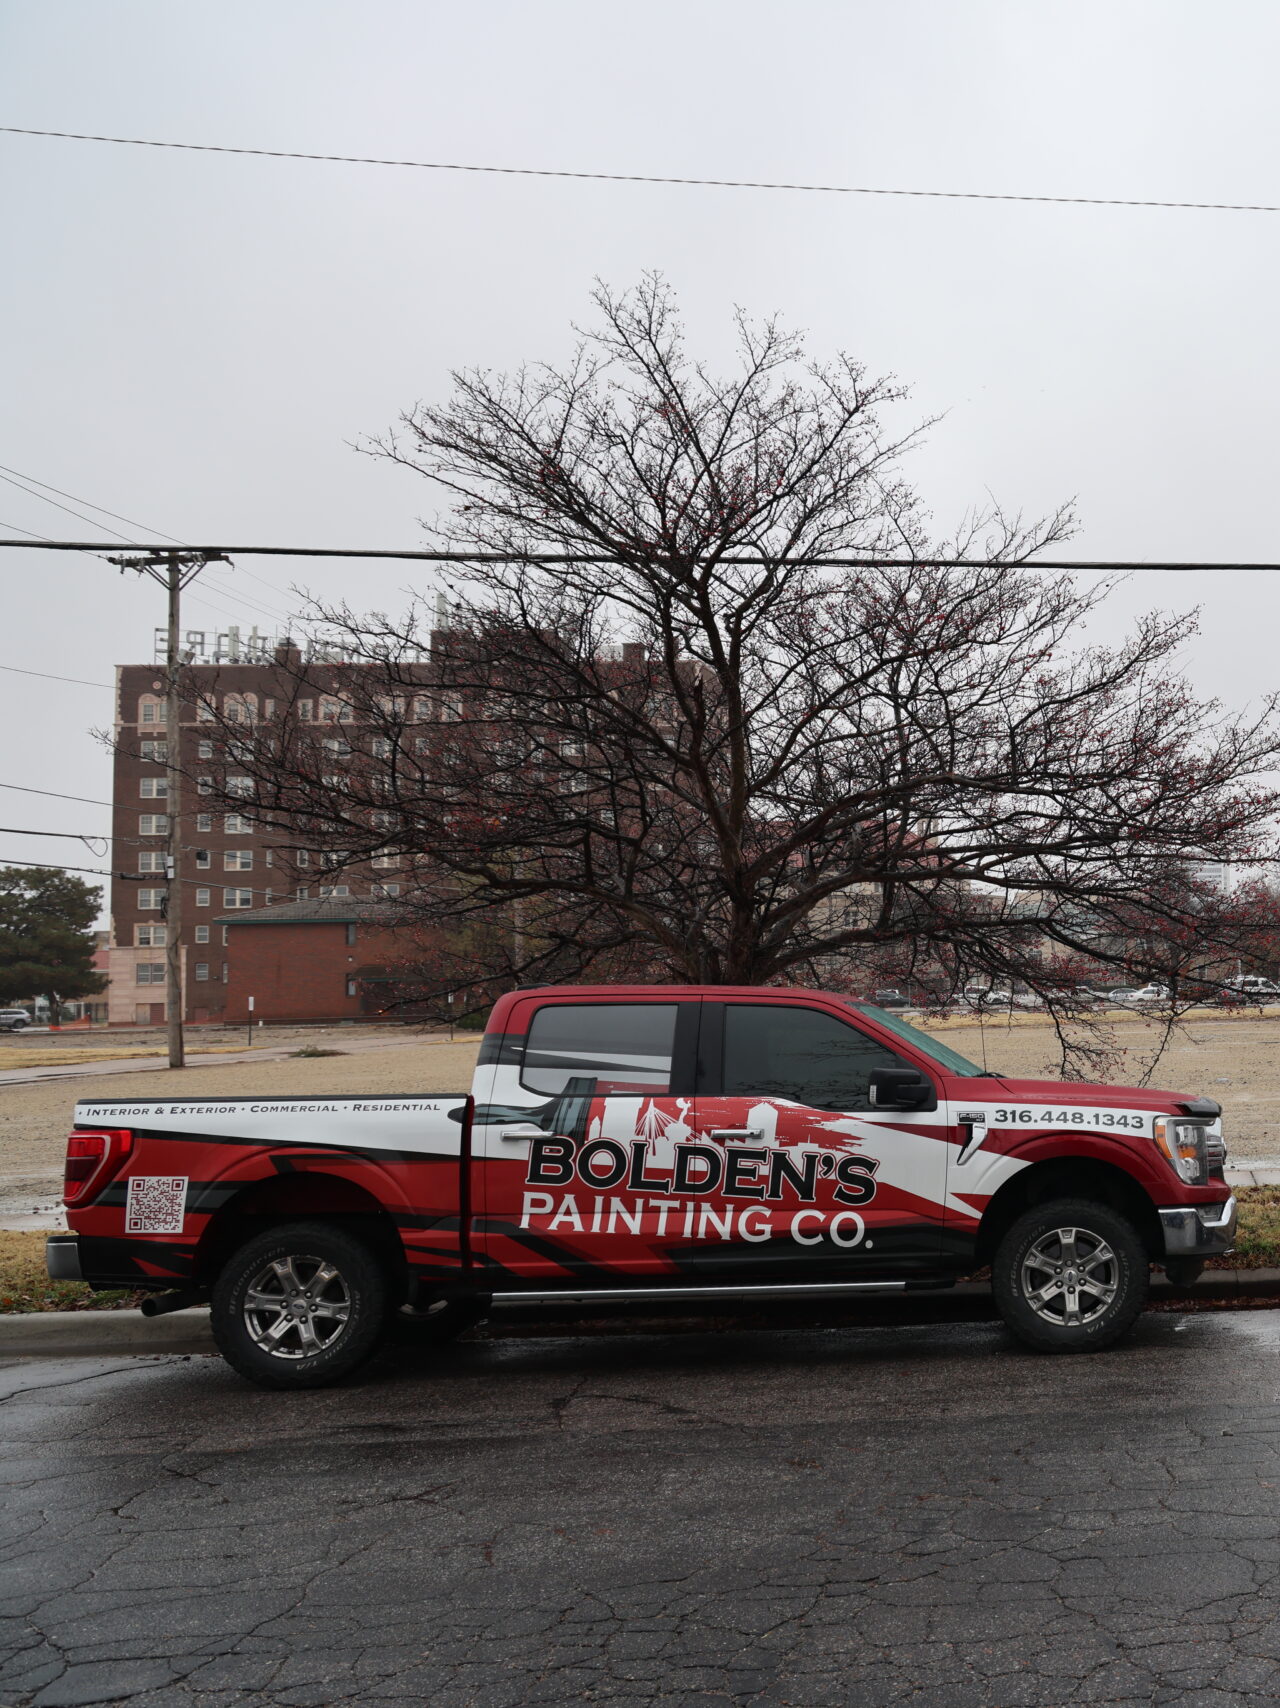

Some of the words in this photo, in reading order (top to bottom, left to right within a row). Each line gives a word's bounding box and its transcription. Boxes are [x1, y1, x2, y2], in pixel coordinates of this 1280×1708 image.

[86, 1107, 149, 1117] INTERIOR
[154, 1106, 165, 1115] &
[169, 1106, 237, 1115] EXTERIOR
[250, 1104, 339, 1113] COMMERCIAL
[352, 1103, 441, 1112] RESIDENTIAL
[994, 1109, 1145, 1129] 316.448.1343
[525, 1135, 881, 1206] BOLDEN'S
[519, 1191, 774, 1243] PAINTING
[790, 1208, 875, 1249] CO.
